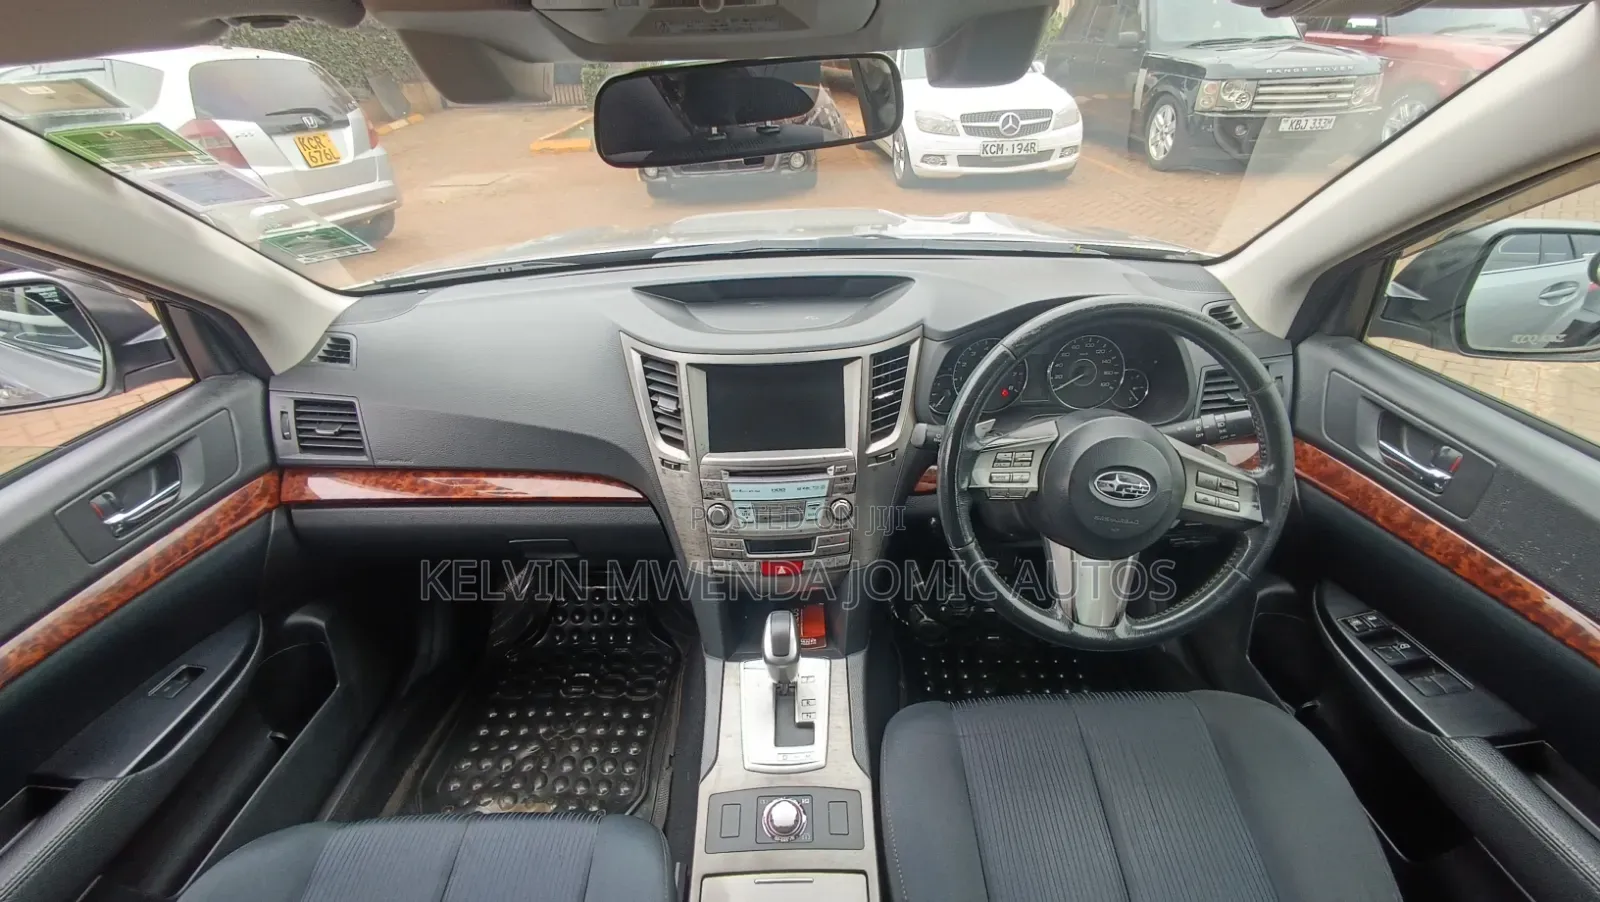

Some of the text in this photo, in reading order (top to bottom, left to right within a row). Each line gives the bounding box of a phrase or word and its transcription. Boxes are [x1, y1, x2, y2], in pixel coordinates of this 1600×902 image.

[1288, 119, 1309, 130] KBJ
[297, 135, 327, 152] KCR
[981, 141, 1037, 155] KCM 194R
[308, 148, 341, 164] 676L
